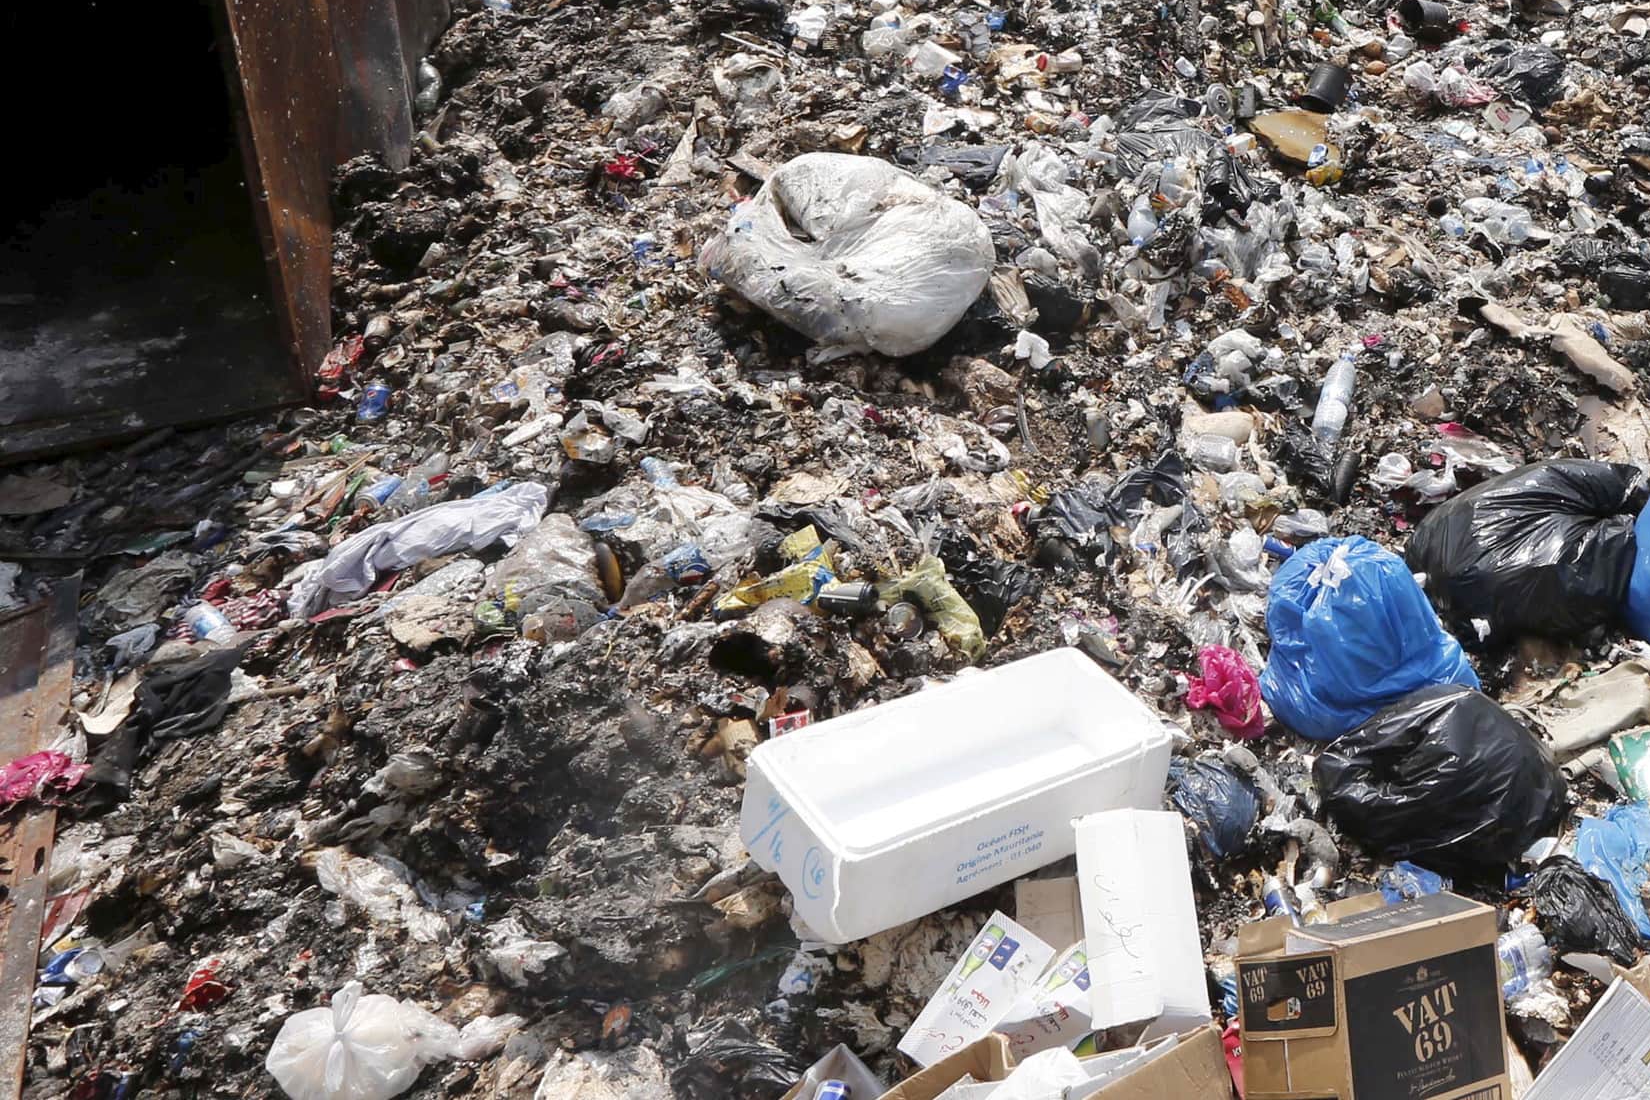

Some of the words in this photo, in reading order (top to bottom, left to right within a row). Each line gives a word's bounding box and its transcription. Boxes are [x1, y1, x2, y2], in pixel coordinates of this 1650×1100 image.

[1008, 823, 1030, 838] FISH
[956, 851, 993, 873] Origine
[993, 830, 1045, 858] Mauritanie
[1241, 965, 1268, 989] VAT
[1295, 960, 1329, 984] VAT
[1250, 985, 1266, 1004] 69
[1305, 980, 1326, 1000] 69
[1392, 981, 1458, 1035] VAT
[1414, 1020, 1453, 1063] 69
